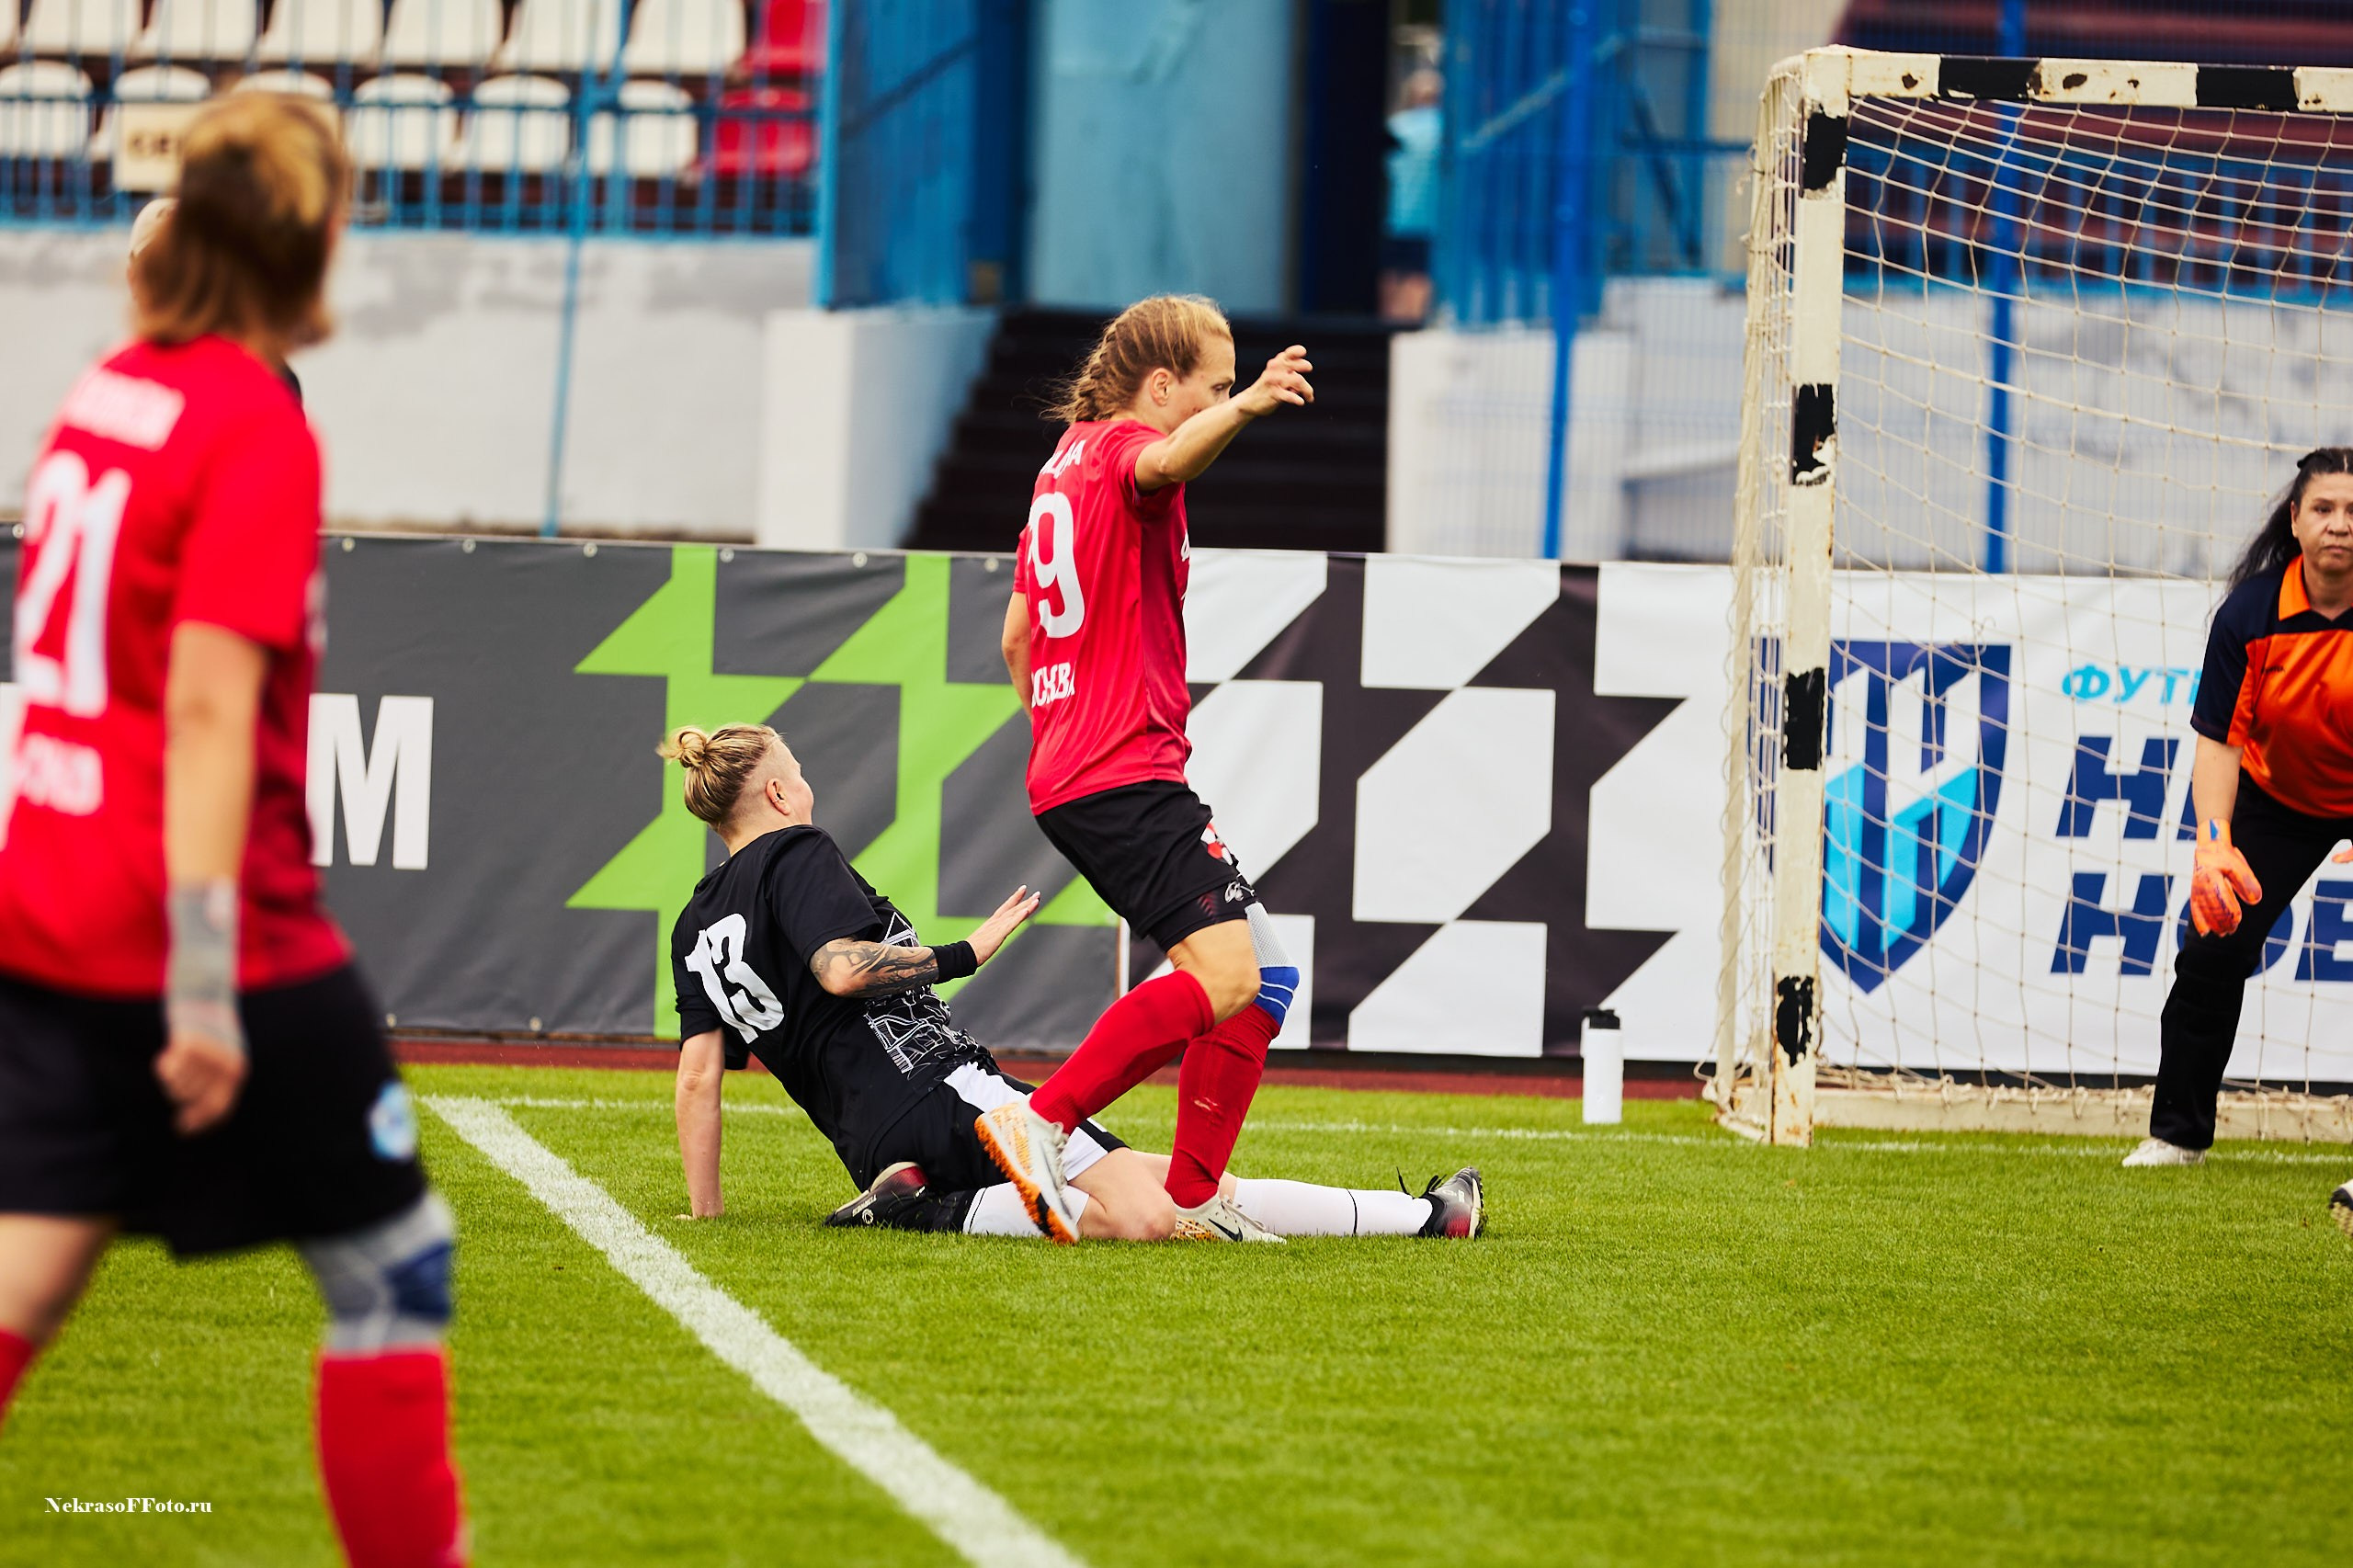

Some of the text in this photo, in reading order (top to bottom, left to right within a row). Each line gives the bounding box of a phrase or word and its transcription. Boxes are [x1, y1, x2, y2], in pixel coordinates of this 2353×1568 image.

[16, 449, 131, 718] 21
[1031, 662, 1075, 709] СКВА
[2062, 665, 2202, 705] ФУТ
[685, 913, 784, 1044] 13
